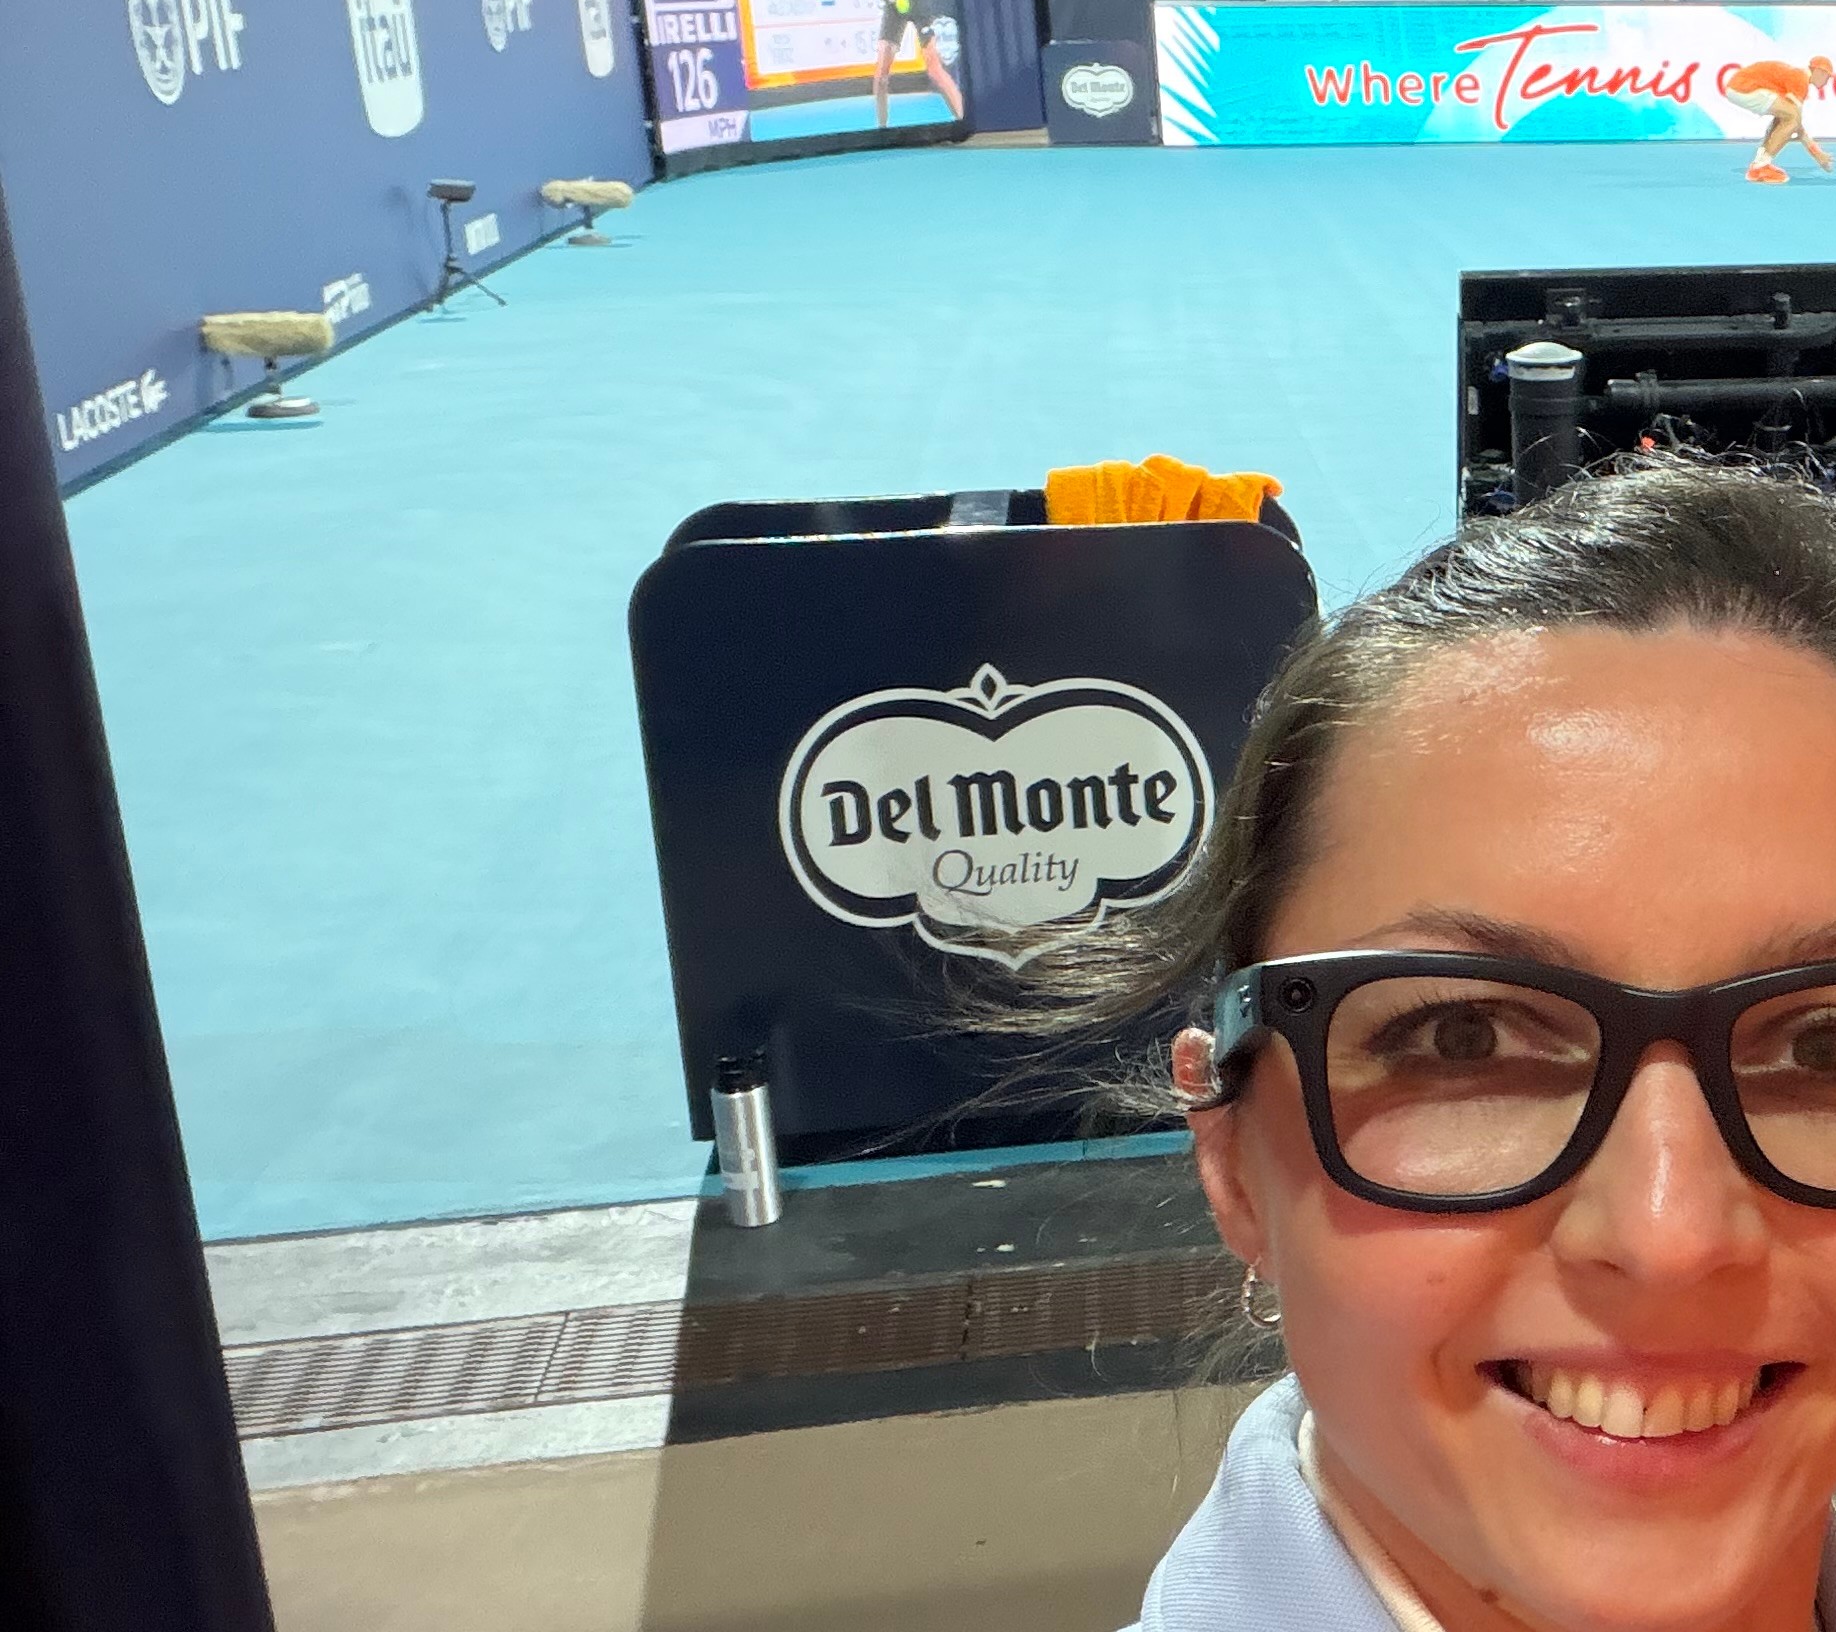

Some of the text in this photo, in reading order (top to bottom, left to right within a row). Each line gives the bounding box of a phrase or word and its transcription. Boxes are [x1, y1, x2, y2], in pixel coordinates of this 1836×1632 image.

[667, 47, 719, 113] 126
[1307, 62, 1481, 105] Where
[1455, 23, 1701, 130] Tennis
[707, 117, 739, 138] MPH
[56, 380, 143, 451] LACOSTE
[819, 761, 1179, 848] Del Monte
[932, 848, 1080, 897] Quality
